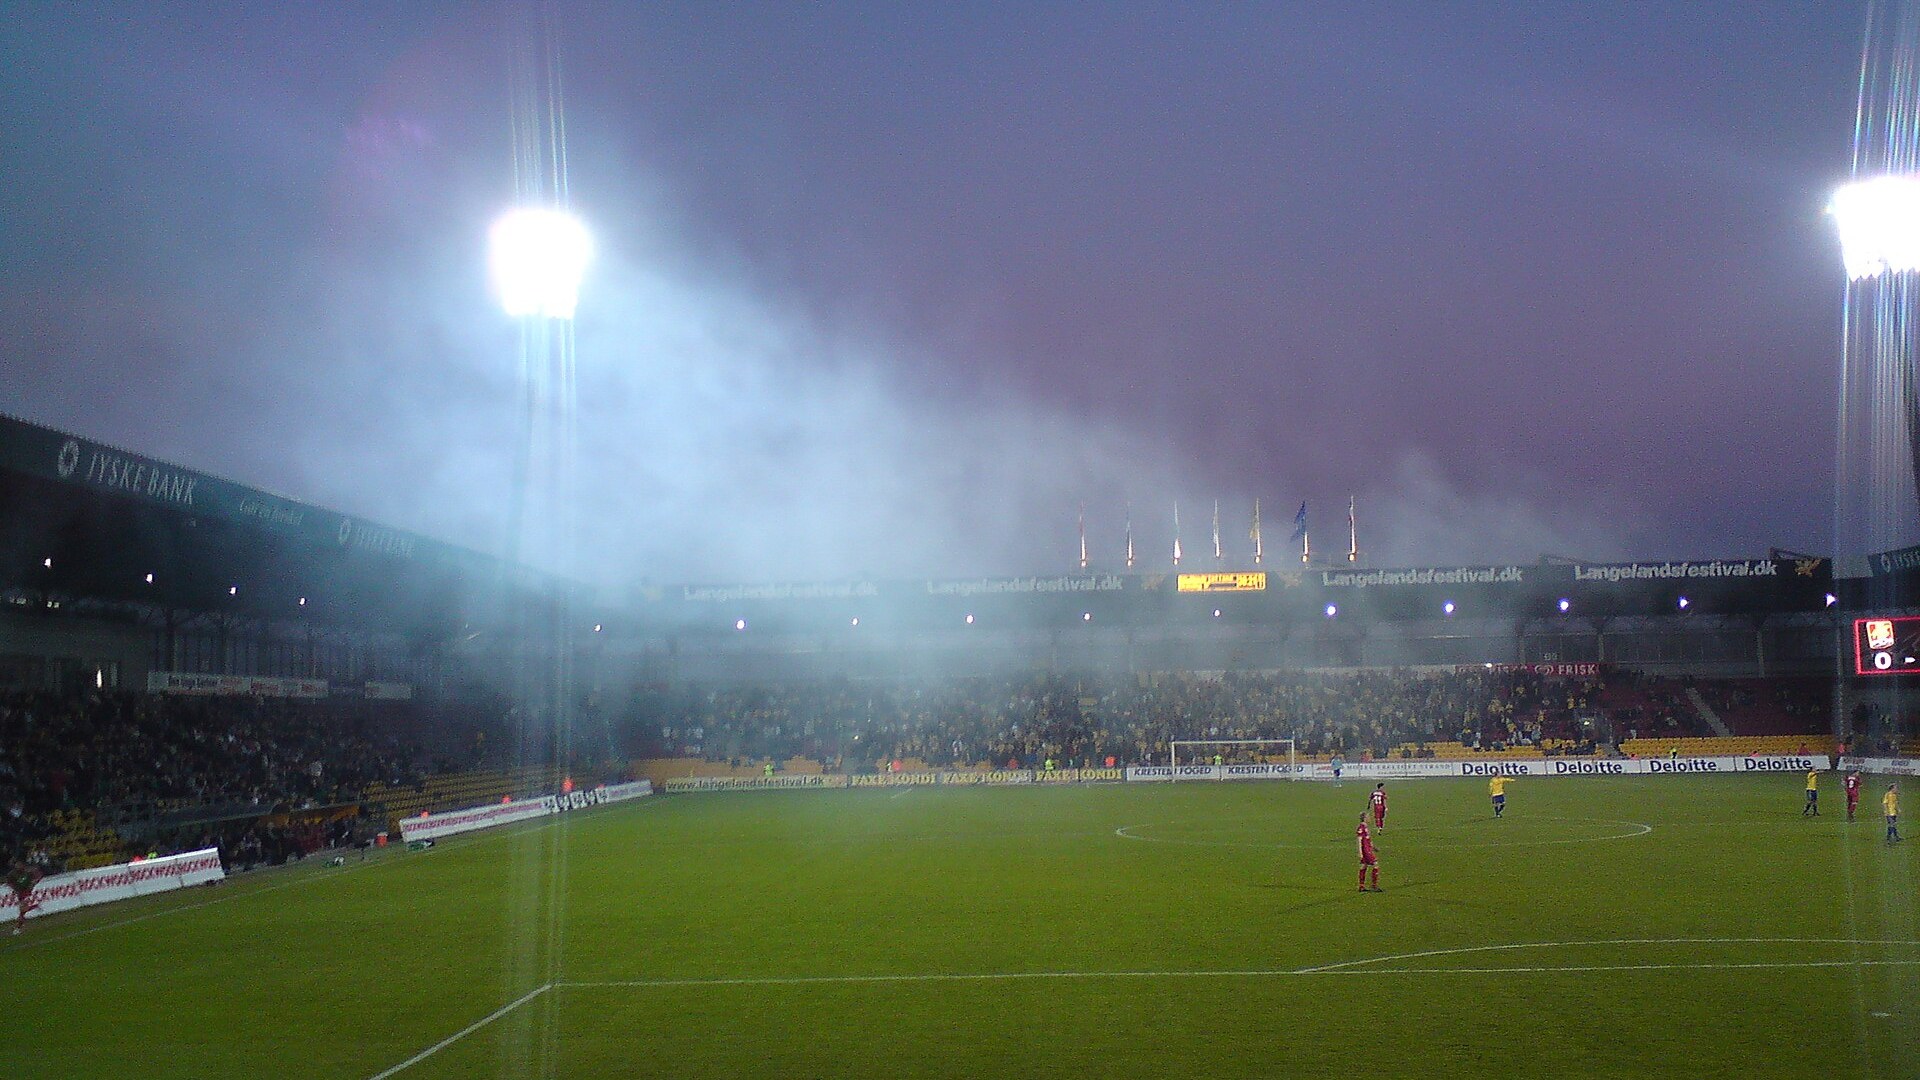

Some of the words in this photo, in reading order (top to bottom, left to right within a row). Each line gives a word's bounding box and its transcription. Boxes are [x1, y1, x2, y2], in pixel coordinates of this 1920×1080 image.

[87, 453, 144, 492] JYSKE
[147, 468, 198, 504] BANK
[1322, 567, 1523, 587] Langelandsfestival.dk
[1575, 561, 1777, 581] Langelandsfestival.dk
[1874, 651, 1892, 670] 0
[1228, 765, 1269, 775] KRESTEN
[1272, 764, 1304, 774] FOGD
[1462, 763, 1528, 775] Deloitte
[1556, 761, 1623, 774] Deloitte
[1650, 759, 1717, 772] Deloitte
[1744, 758, 1812, 771] Deloitte
